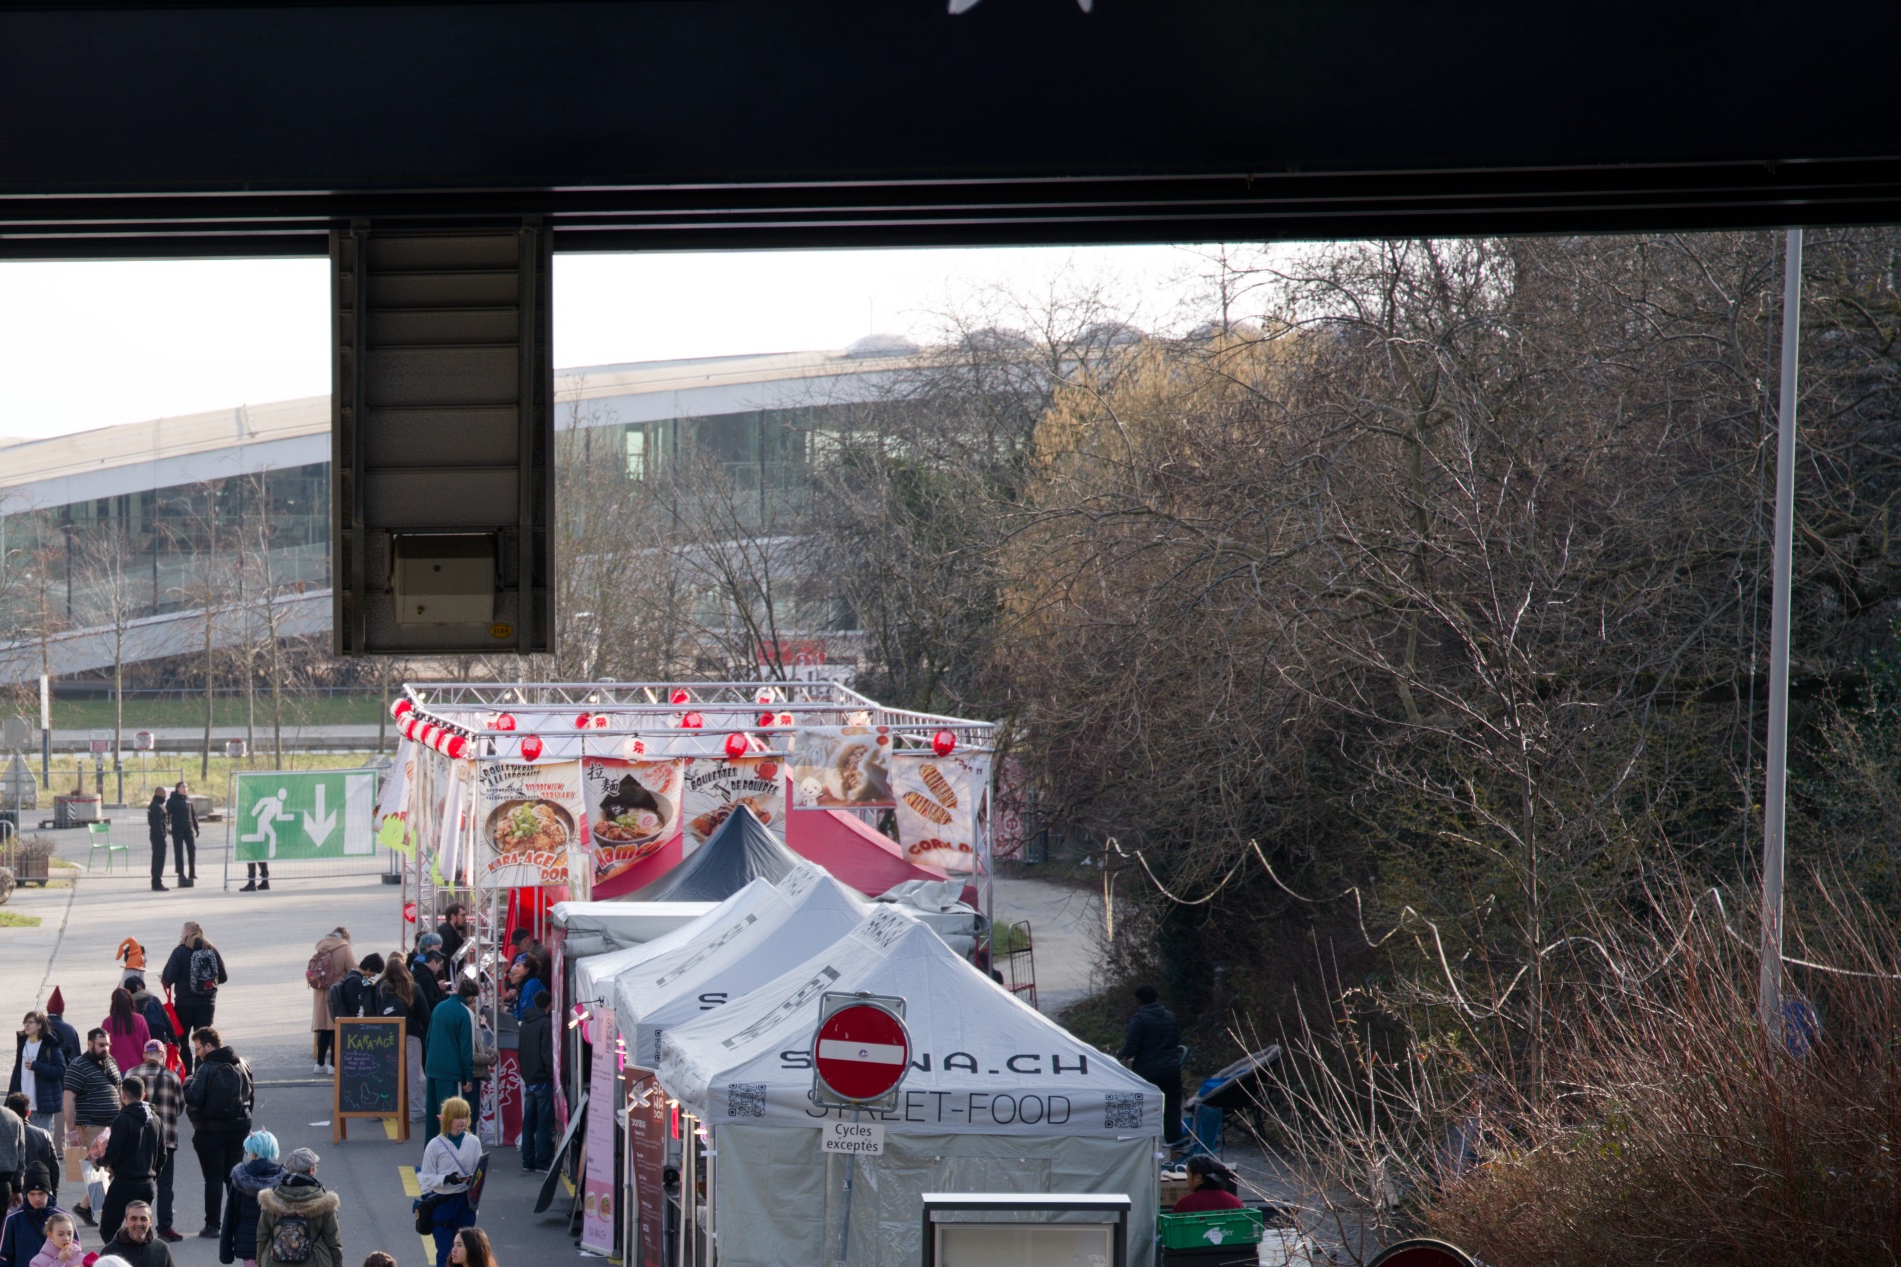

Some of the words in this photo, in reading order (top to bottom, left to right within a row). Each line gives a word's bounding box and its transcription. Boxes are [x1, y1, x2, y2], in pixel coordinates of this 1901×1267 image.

[487, 850, 558, 873] KARA-AGE
[835, 1124, 872, 1139] Cycles
[826, 1138, 878, 1153] exceptés
